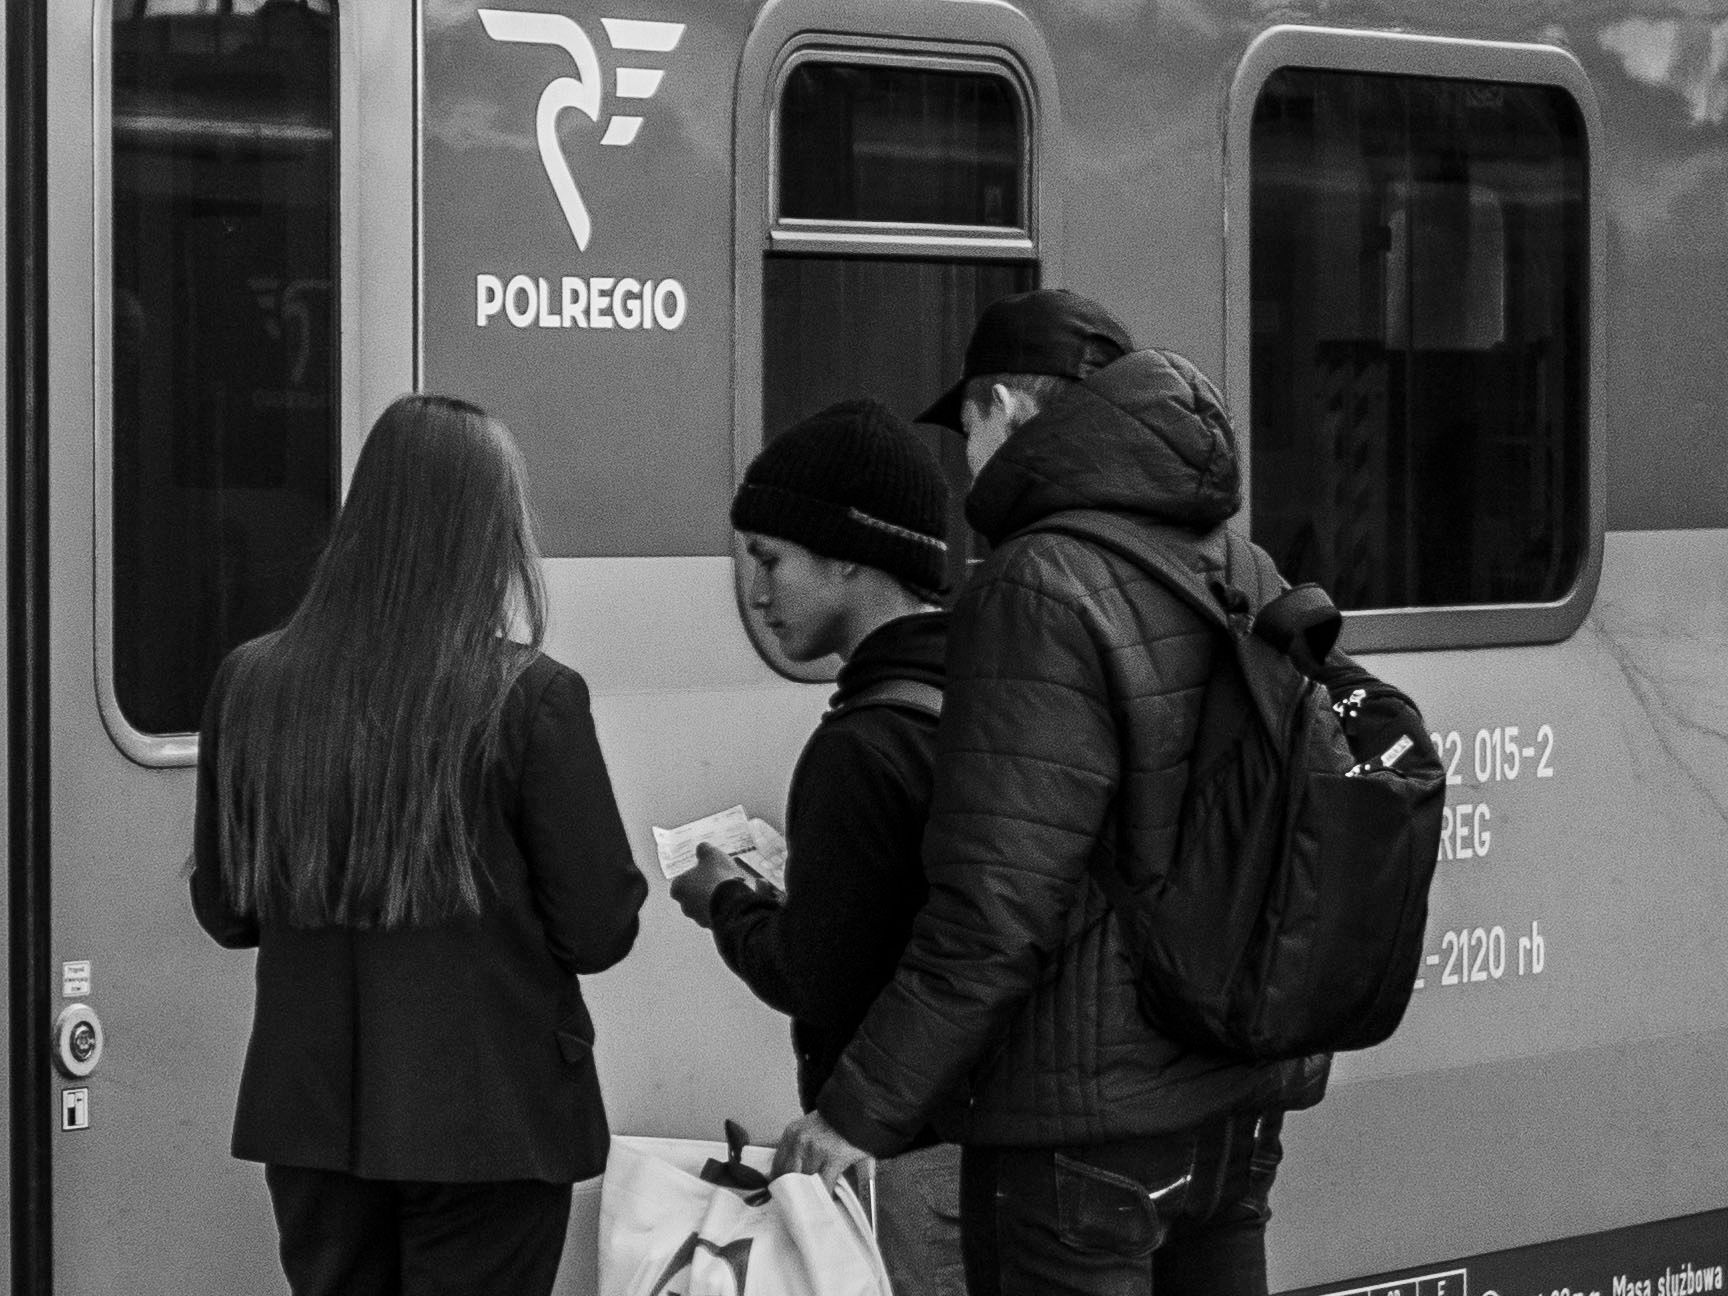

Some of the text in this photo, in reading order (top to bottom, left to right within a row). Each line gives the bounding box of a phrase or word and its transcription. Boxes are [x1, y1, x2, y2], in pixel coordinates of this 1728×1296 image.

[476, 273, 687, 330] POLREGIO
[1474, 724, 1555, 783] 015-2
[1414, 920, 1545, 989] -2120 rb
